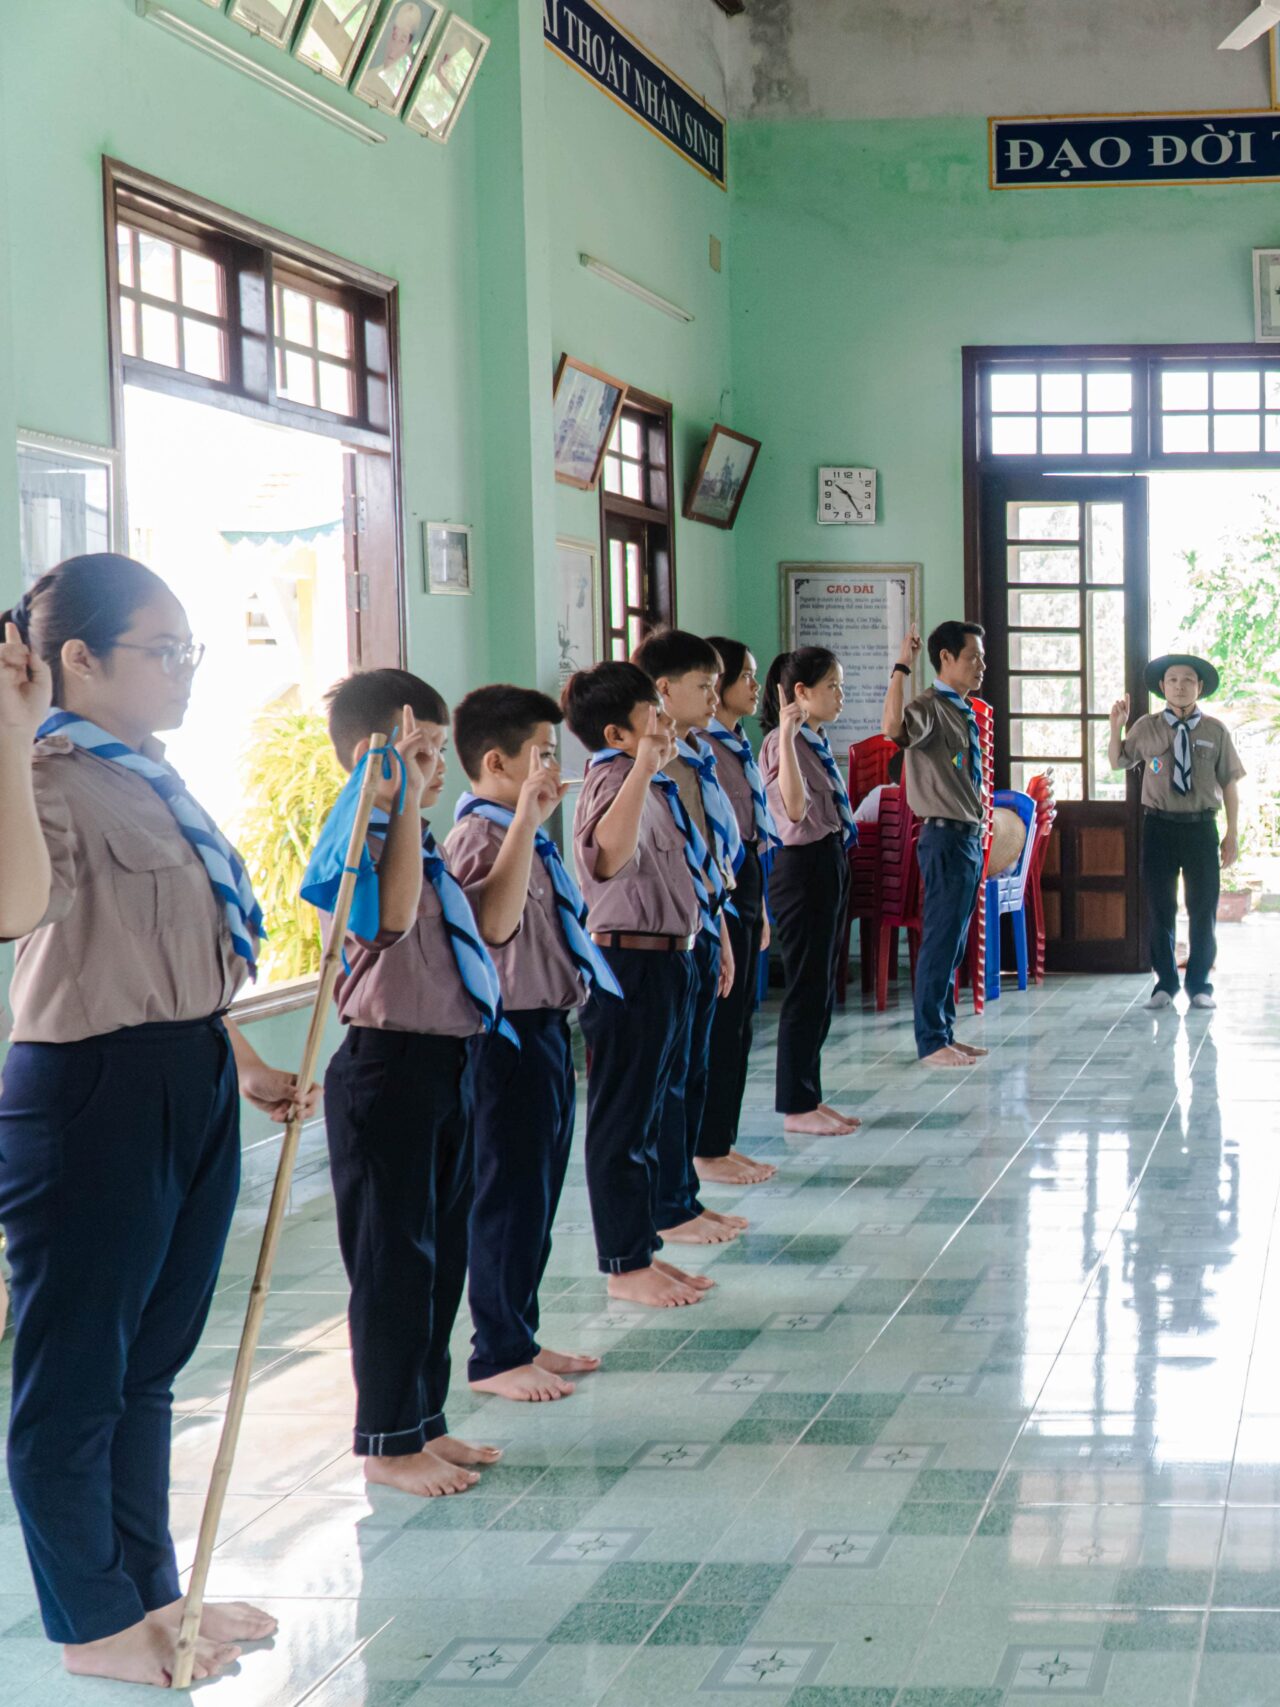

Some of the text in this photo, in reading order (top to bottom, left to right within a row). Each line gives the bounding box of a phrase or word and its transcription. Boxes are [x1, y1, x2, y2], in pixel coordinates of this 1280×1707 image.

[563, 5, 630, 98] THOÁT
[634, 67, 681, 140] NHÂN
[684, 111, 720, 171] SINH
[1003, 136, 1132, 178] ĐẠO
[1147, 123, 1256, 167] ĐỜI
[827, 585, 850, 594] CAO
